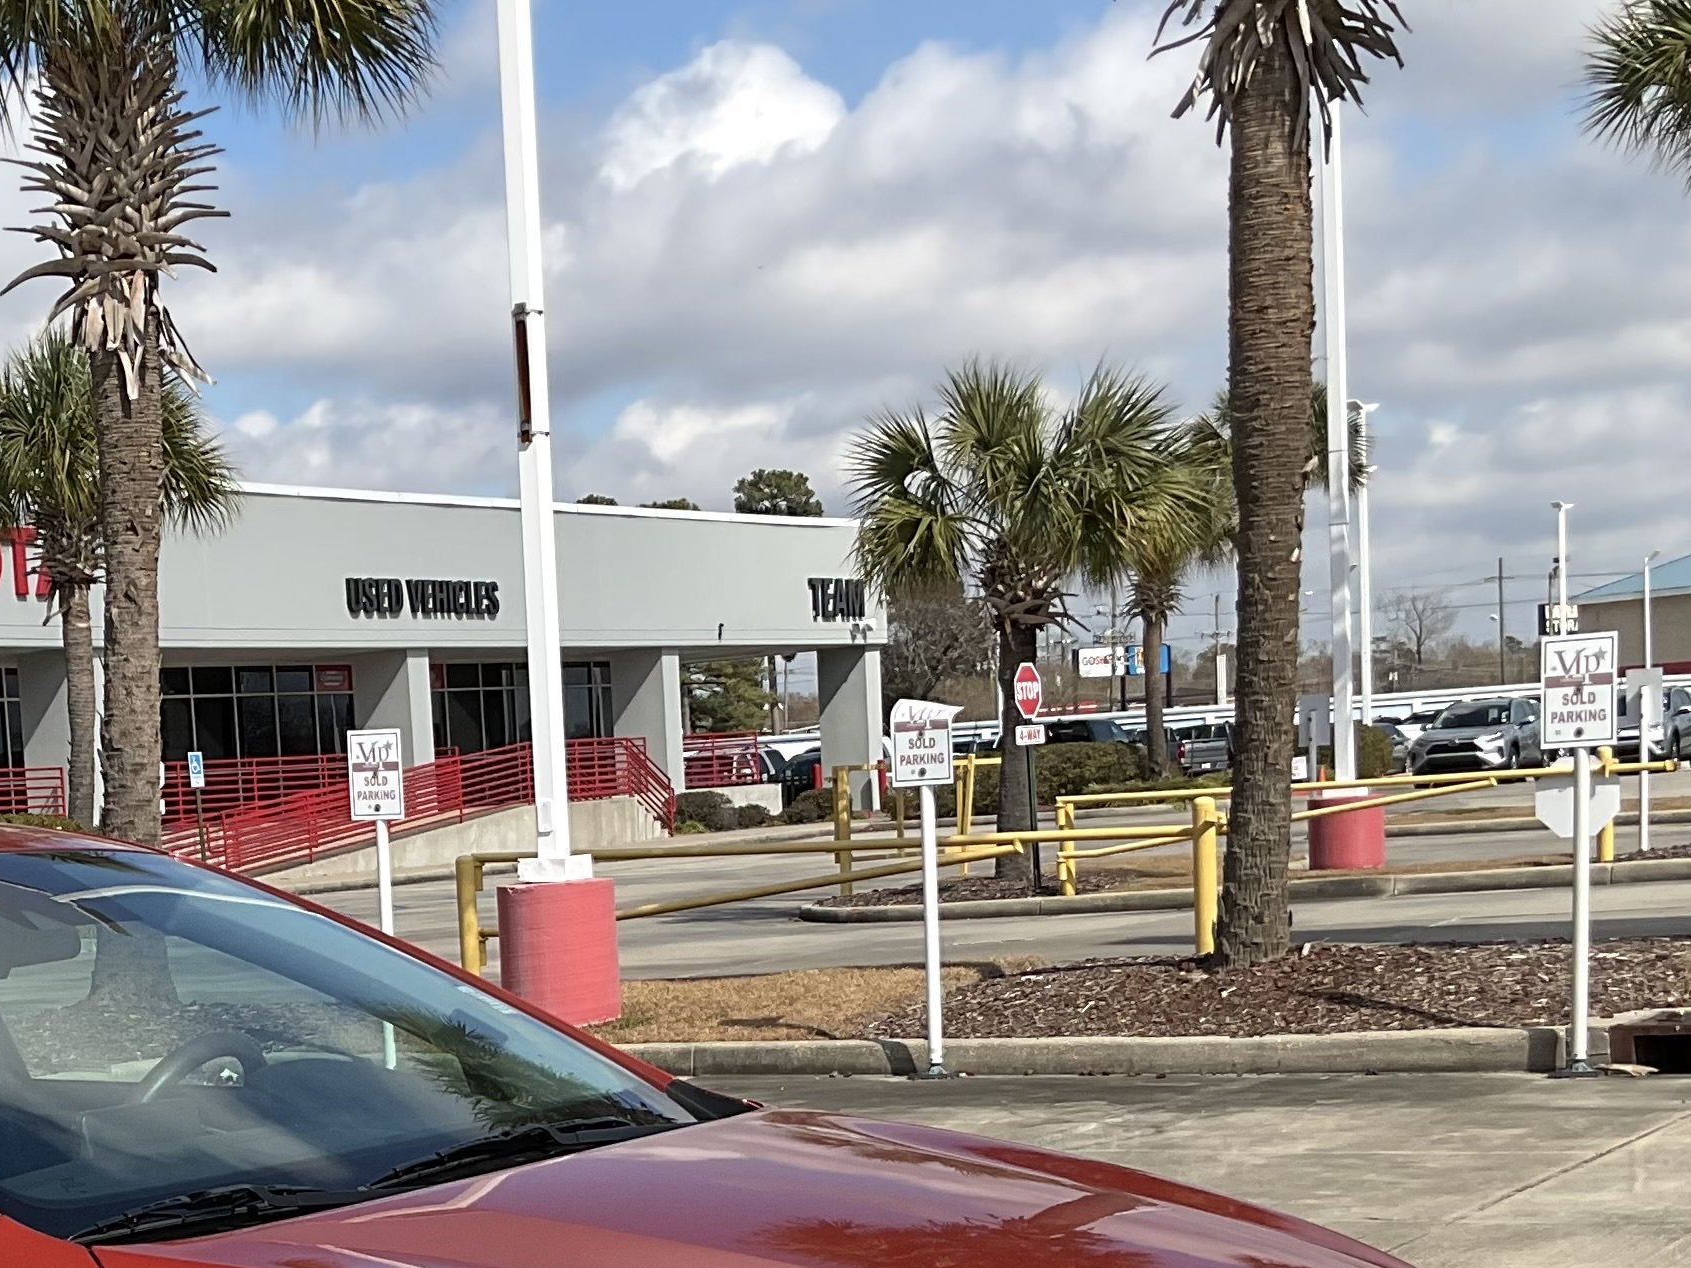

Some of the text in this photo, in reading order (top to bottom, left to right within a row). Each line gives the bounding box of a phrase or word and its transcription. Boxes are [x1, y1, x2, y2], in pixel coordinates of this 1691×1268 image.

[345, 577, 500, 616] USED VEHICLES
[807, 577, 866, 618] TEAM
[1016, 681, 1039, 701] STOP
[1562, 692, 1596, 706] SOLD
[1551, 709, 1607, 724] PARKING
[1019, 729, 1041, 741] 4-WAY
[909, 737, 936, 750] SOLD
[900, 752, 946, 766] PARKING
[364, 776, 388, 787] SOLD
[357, 790, 397, 801] PARKING
